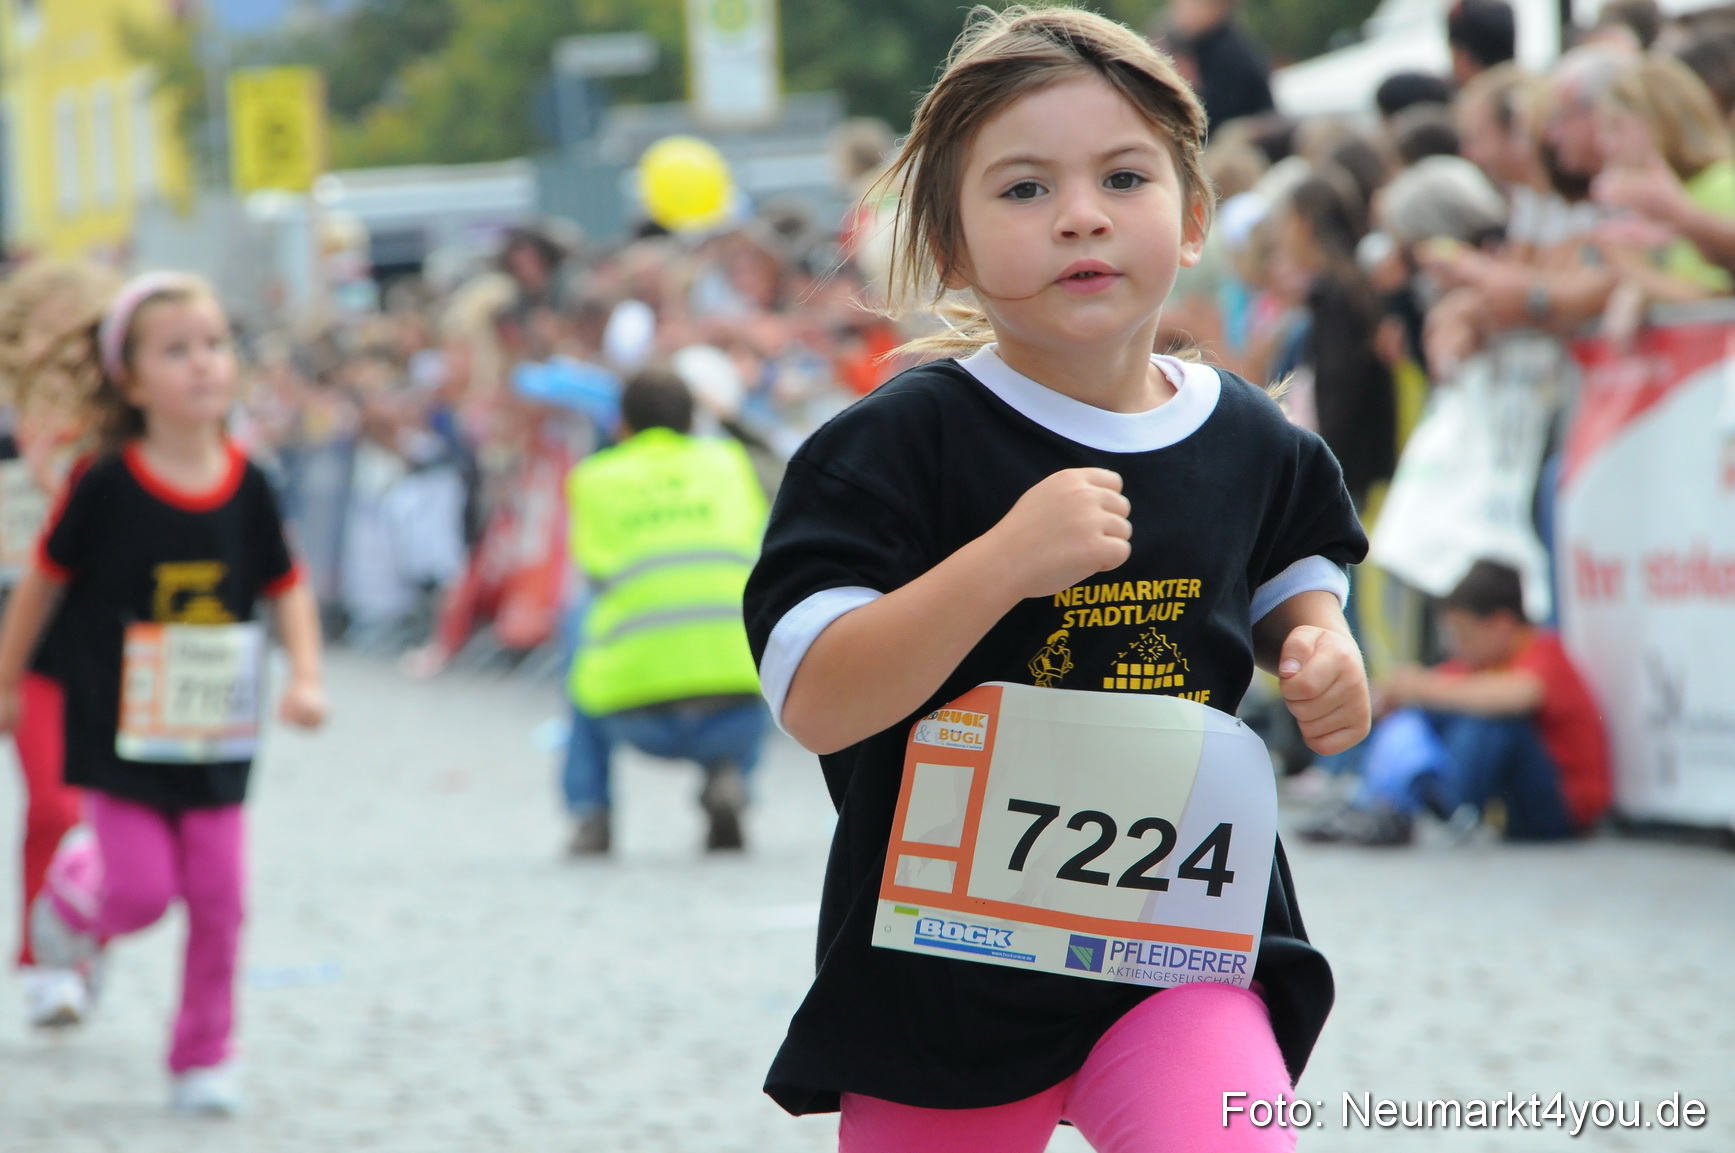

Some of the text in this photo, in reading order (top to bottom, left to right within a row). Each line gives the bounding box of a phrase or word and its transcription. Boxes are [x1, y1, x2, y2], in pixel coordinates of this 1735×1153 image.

[1053, 578, 1202, 608] NEUMARKTER
[1061, 602, 1186, 629] STADTLAUF
[915, 724, 983, 745] & BÖGL
[1007, 798, 1236, 898] 7224
[915, 917, 1014, 948] BOCK
[1109, 940, 1248, 974] PFLEIDERER
